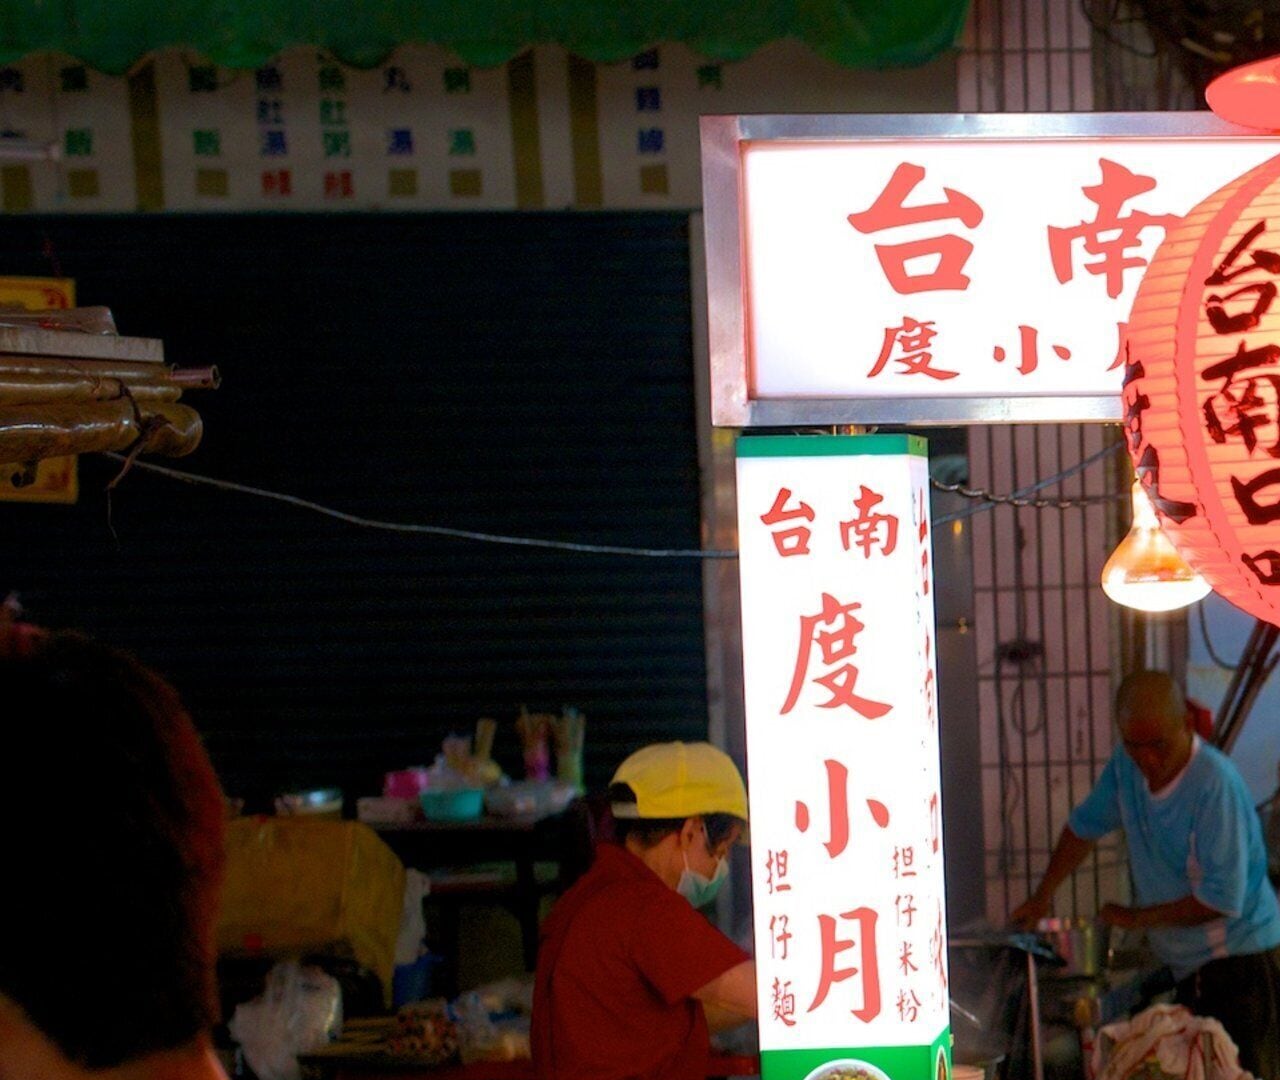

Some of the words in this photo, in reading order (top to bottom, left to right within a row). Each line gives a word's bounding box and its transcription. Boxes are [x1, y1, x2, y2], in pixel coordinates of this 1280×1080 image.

[847, 158, 1190, 300] 台南
[866, 315, 1130, 381] 度小
[760, 484, 899, 559] 台南
[779, 592, 894, 1025] 度小月
